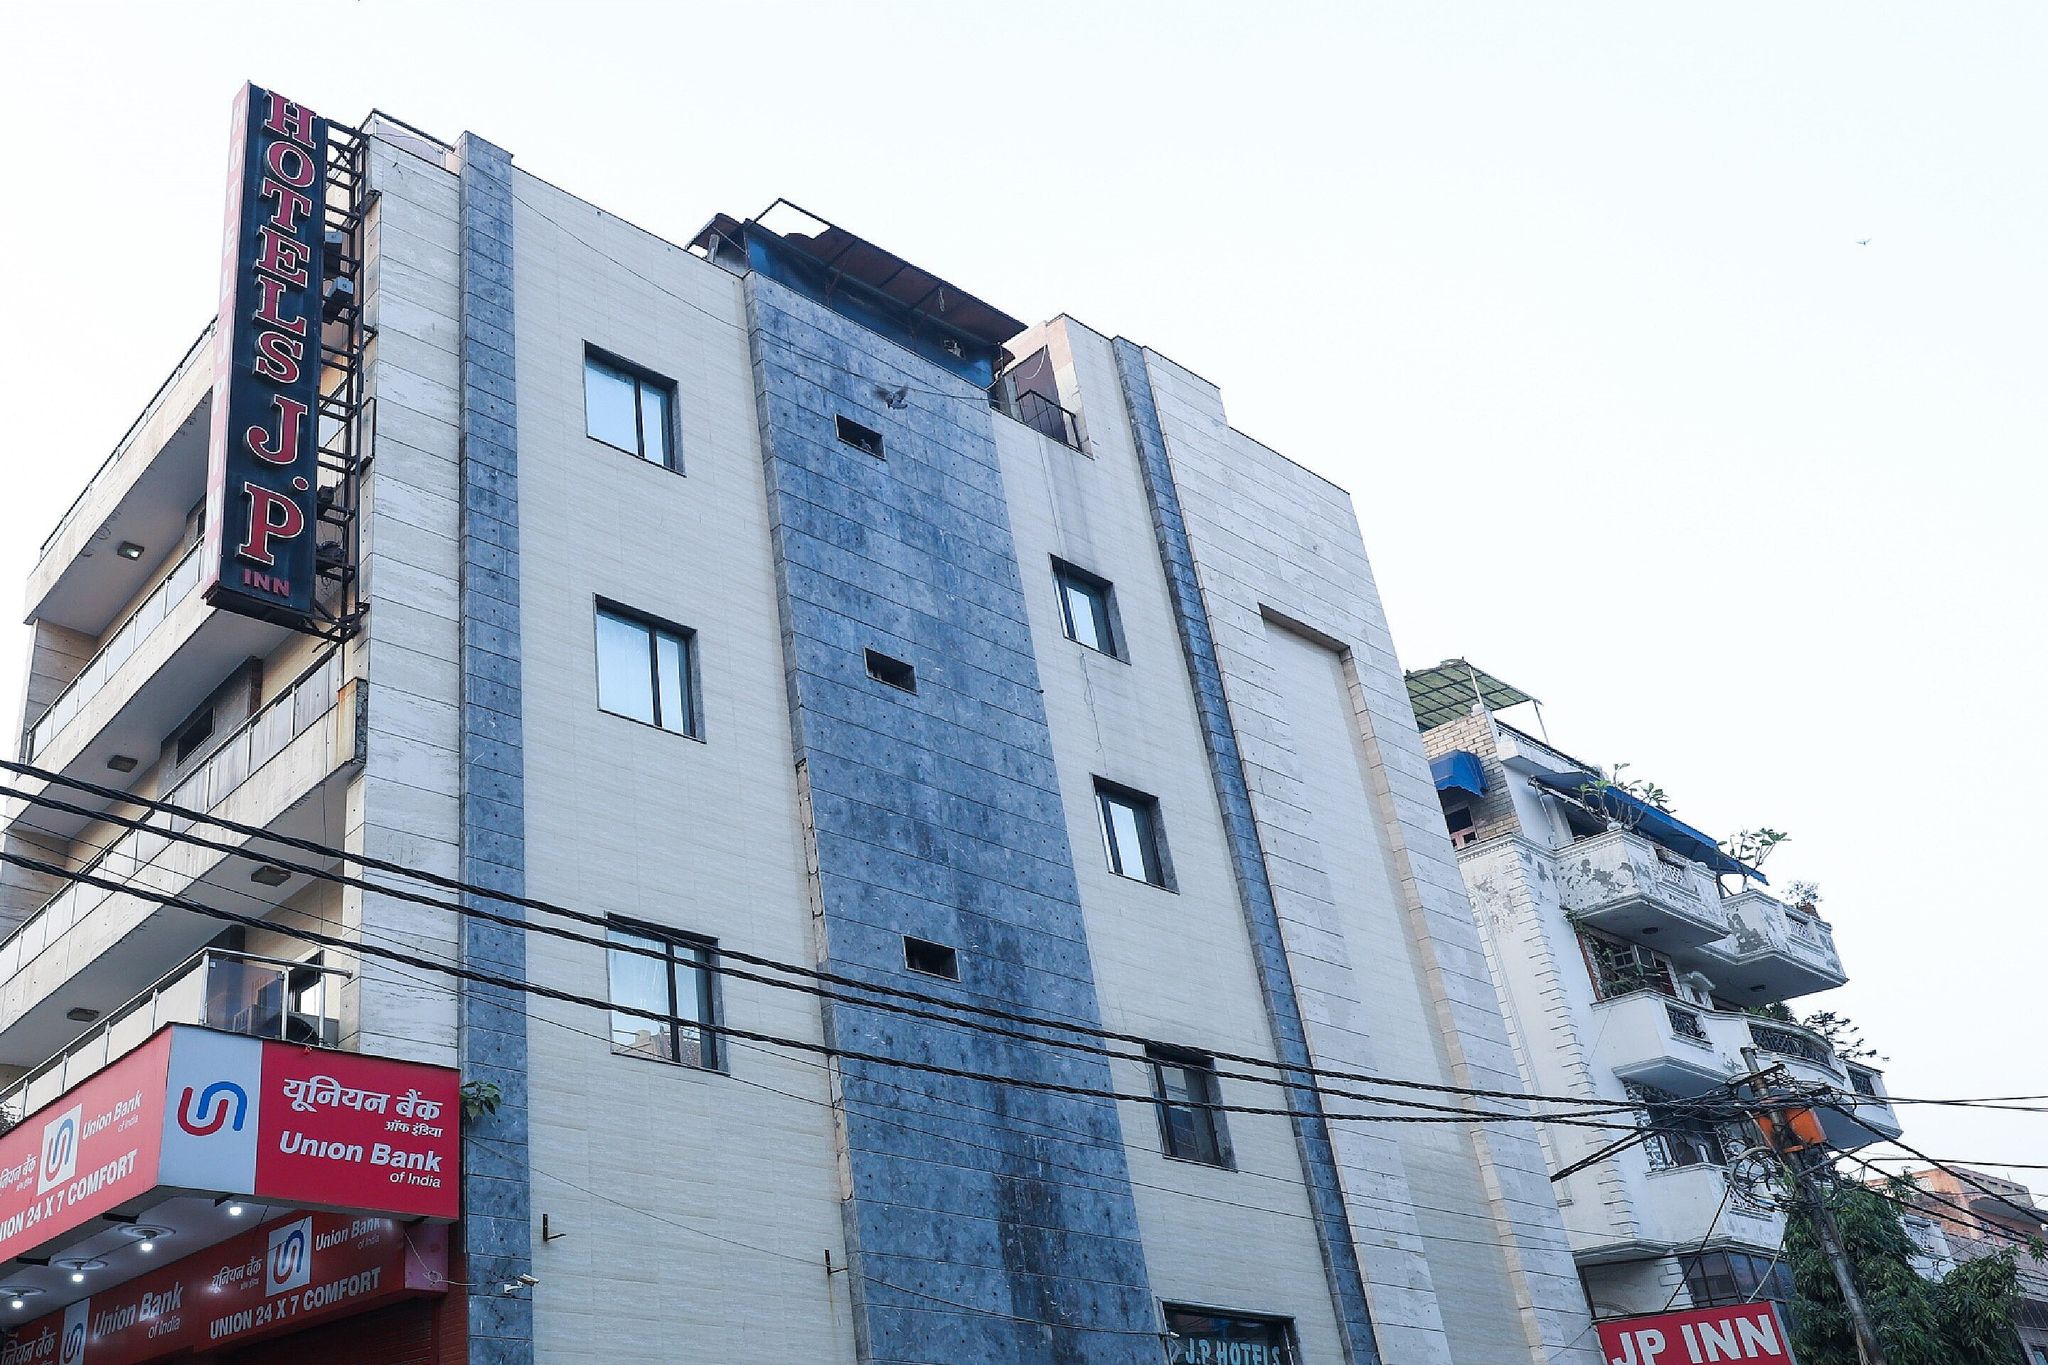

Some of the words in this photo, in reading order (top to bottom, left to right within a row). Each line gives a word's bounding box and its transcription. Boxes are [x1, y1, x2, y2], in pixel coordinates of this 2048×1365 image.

[255, 89, 317, 384] HOTELS
[243, 568, 290, 598] INN
[82, 1111, 112, 1140] Union
[113, 1090, 143, 1121] Bank
[283, 1075, 391, 1113] यूनियन
[396, 1088, 444, 1121] बैंक
[279, 1130, 363, 1163] Union
[370, 1142, 443, 1173] Bank
[411, 1122, 443, 1138] इंडिया
[26, 1202, 42, 1229] 24
[44, 1196, 54, 1219] X
[57, 1188, 66, 1213] 7
[67, 1148, 139, 1206] COMFORT
[389, 1171, 406, 1183] of
[407, 1172, 442, 1188] India
[315, 1227, 349, 1252] Union
[351, 1217, 382, 1239] Bank
[92, 1303, 137, 1342] Union
[139, 1281, 183, 1322] Bank
[209, 1309, 253, 1340] UNION
[255, 1303, 273, 1328] 24
[275, 1297, 287, 1320] X
[290, 1294, 300, 1316] 7
[303, 1266, 381, 1311] COMFORT
[148, 1320, 158, 1339] of
[158, 1315, 182, 1337] India
[1612, 1328, 1667, 1365] JP
[1680, 1314, 1782, 1364] INN
[1216, 1340, 1281, 1365] HOTELS
